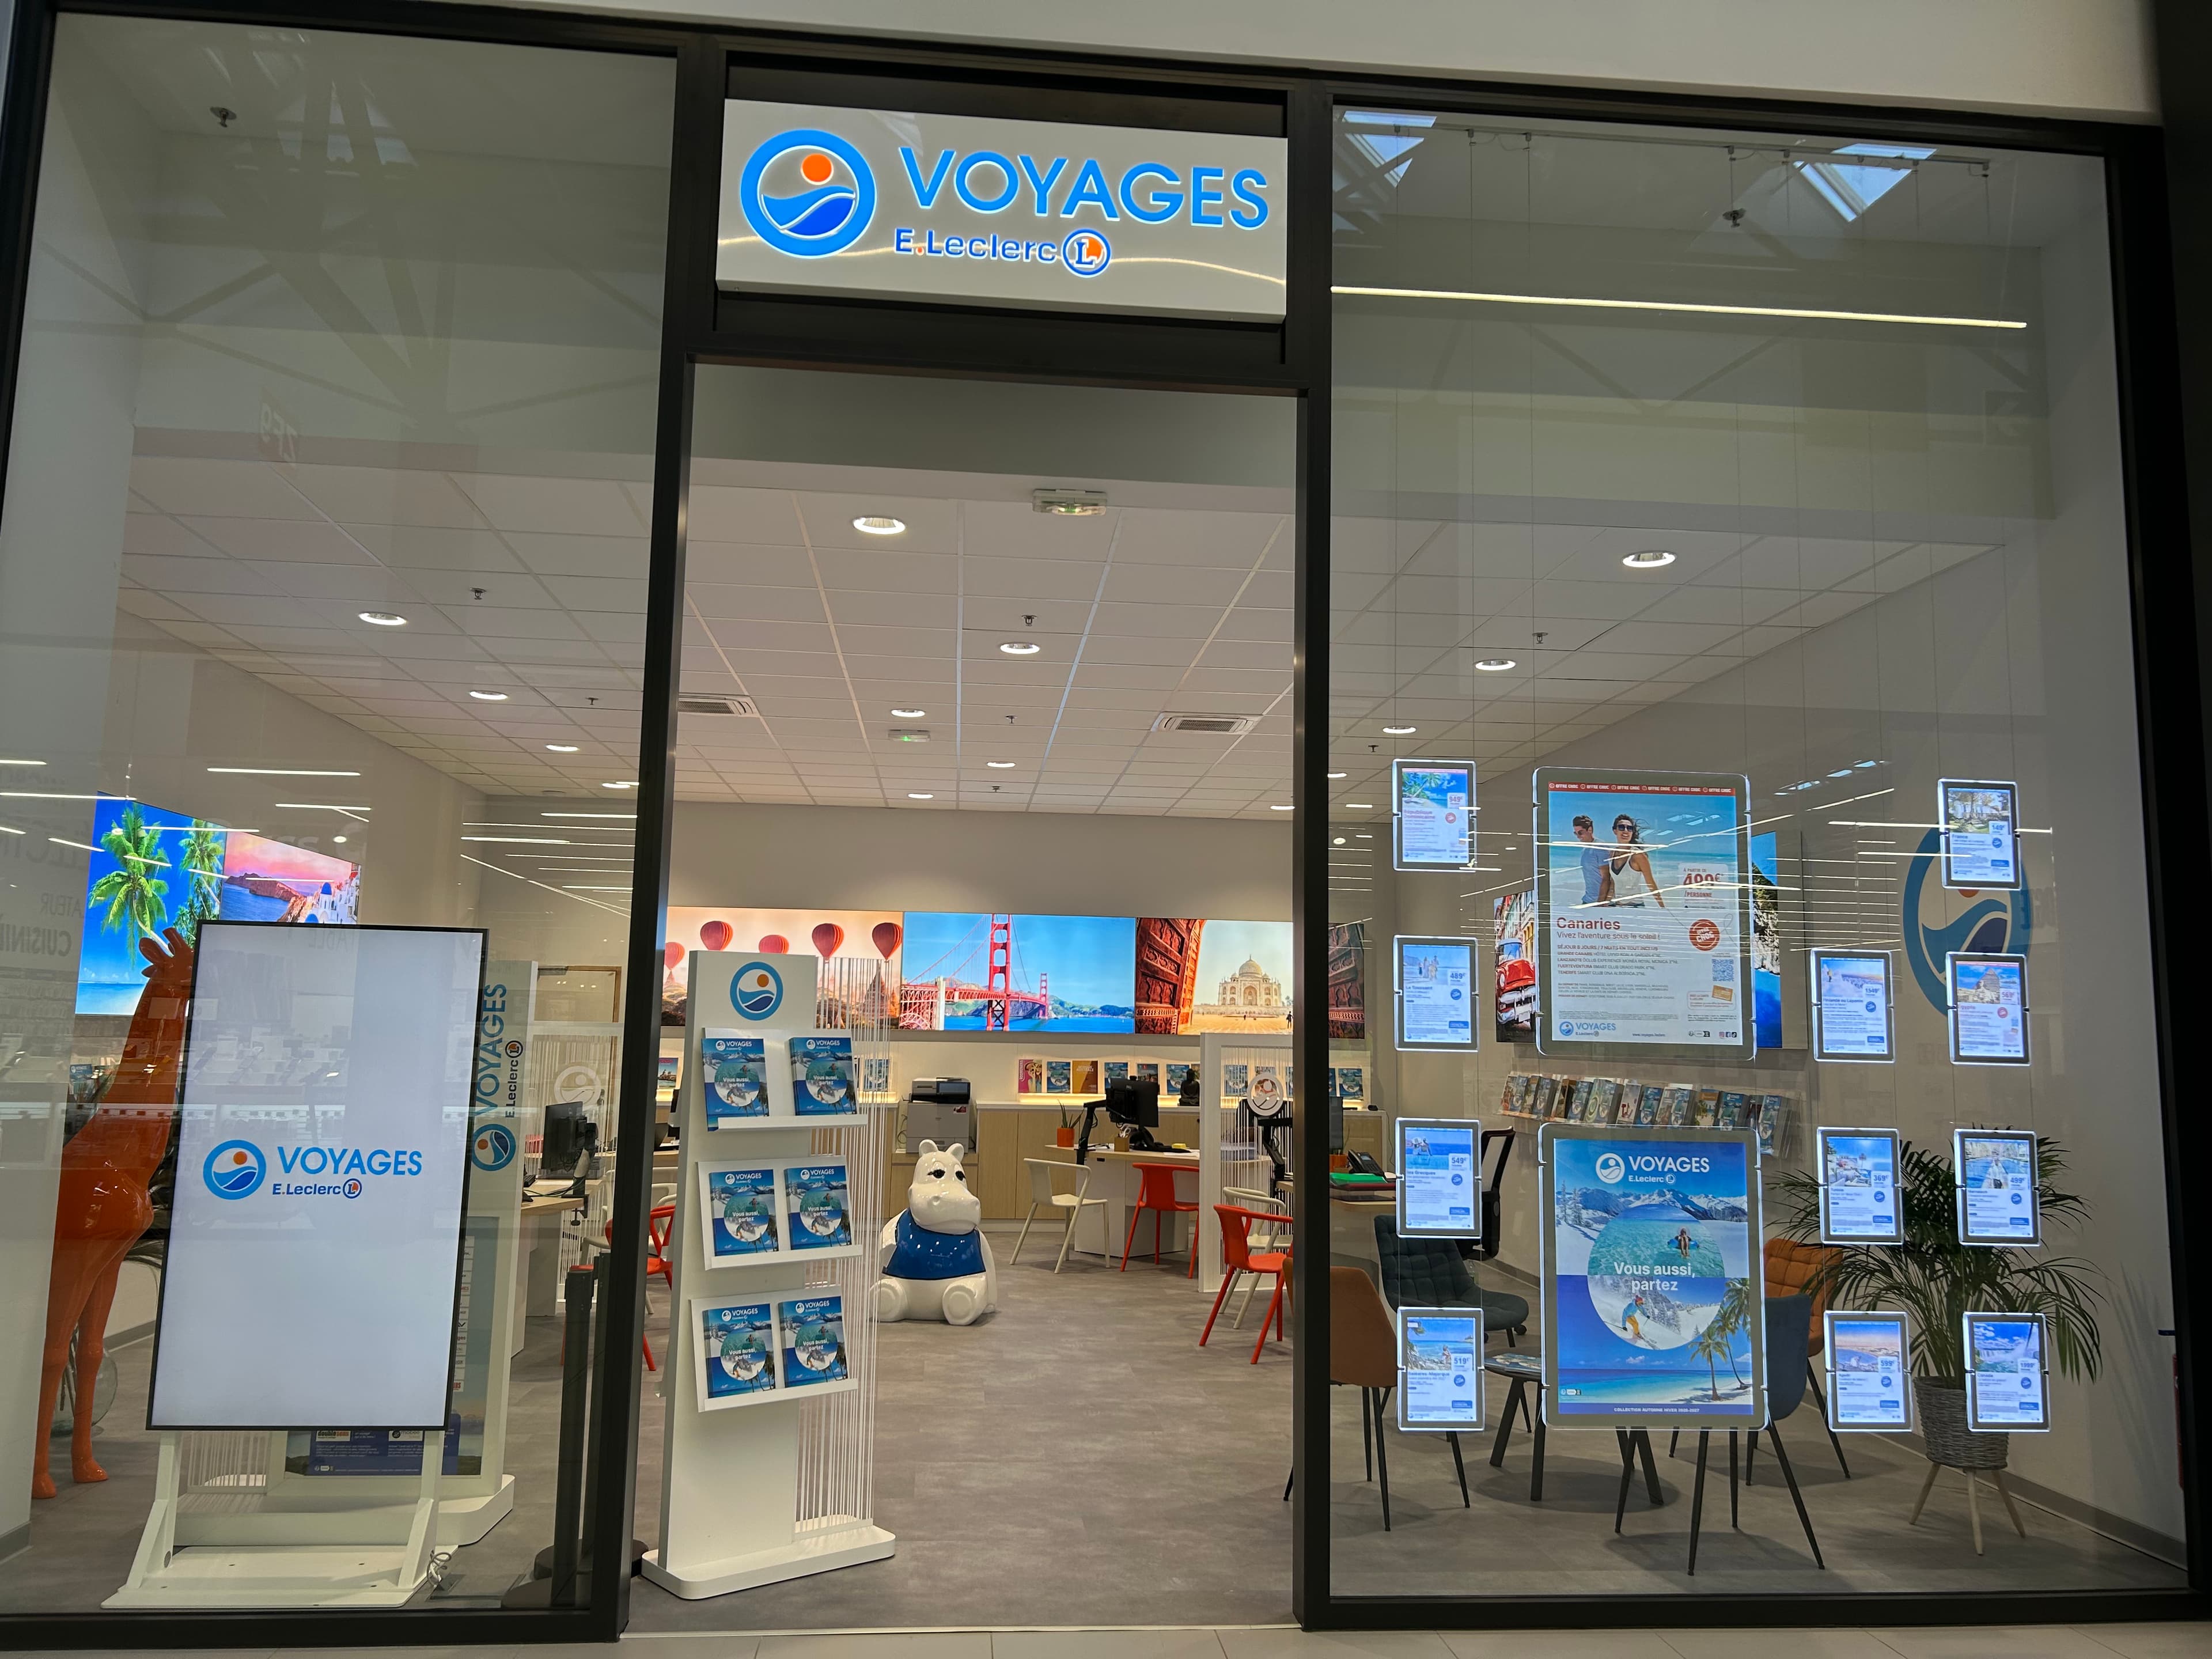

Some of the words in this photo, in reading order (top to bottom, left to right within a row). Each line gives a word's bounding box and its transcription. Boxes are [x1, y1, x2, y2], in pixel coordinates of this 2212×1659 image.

[898, 146, 1269, 231] VOYAGES
[894, 227, 1057, 264] E.Leclerc
[1556, 917, 1620, 930] Canaries
[1575, 1022, 1616, 1031] VOYAGES
[471, 984, 507, 1118] VOYAGES
[505, 1059, 519, 1119] E.Leclerc
[277, 1146, 423, 1176] VOYAGES
[1628, 1156, 1710, 1173] VOYAGES
[1628, 1175, 1664, 1184] E.Leclerc
[272, 1183, 342, 1196] E.Leclerc
[1613, 1262, 1650, 1276] Vous
[1653, 1261, 1696, 1278] aussi,
[1631, 1278, 1678, 1293] partez
[805, 1300, 830, 1308] VOYAGES
